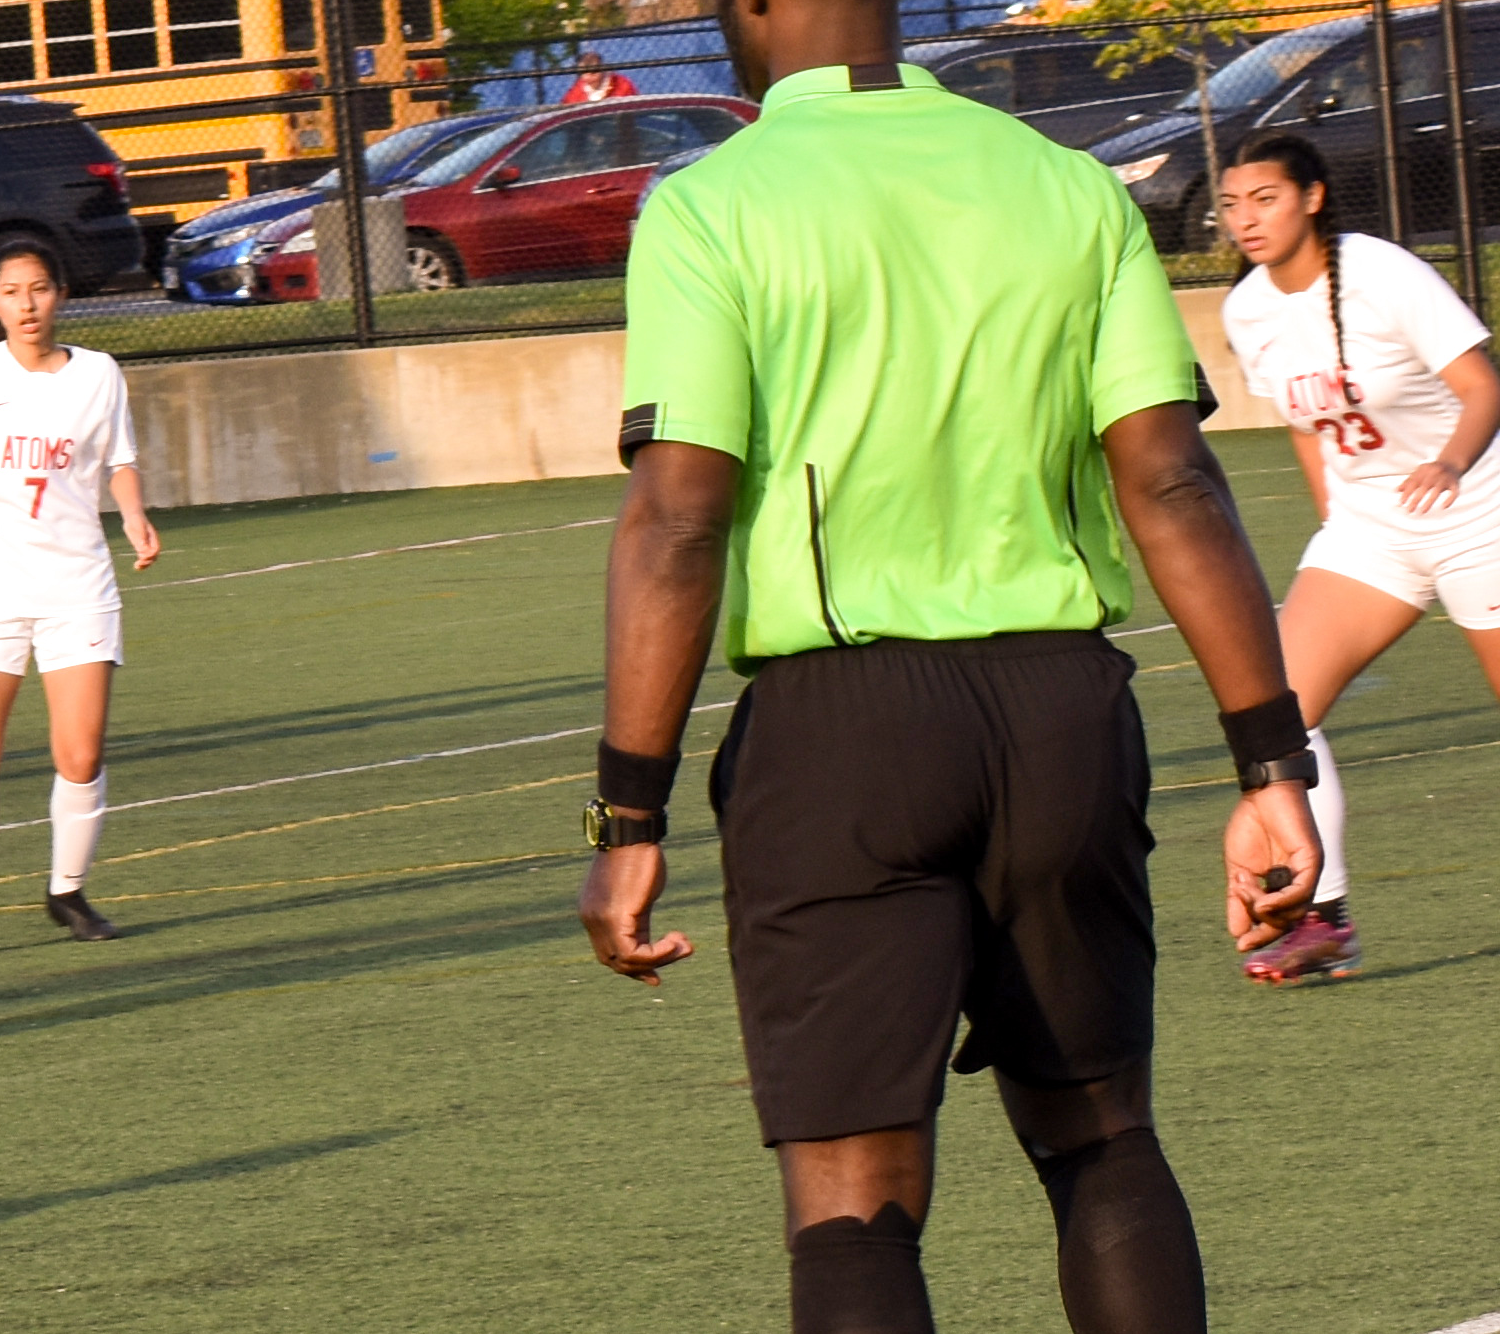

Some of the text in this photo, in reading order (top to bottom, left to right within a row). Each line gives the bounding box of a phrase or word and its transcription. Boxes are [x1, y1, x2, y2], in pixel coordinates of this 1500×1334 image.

[1, 435, 74, 470] ATOMS
[1314, 412, 1385, 456] 23
[24, 478, 49, 519] 7
